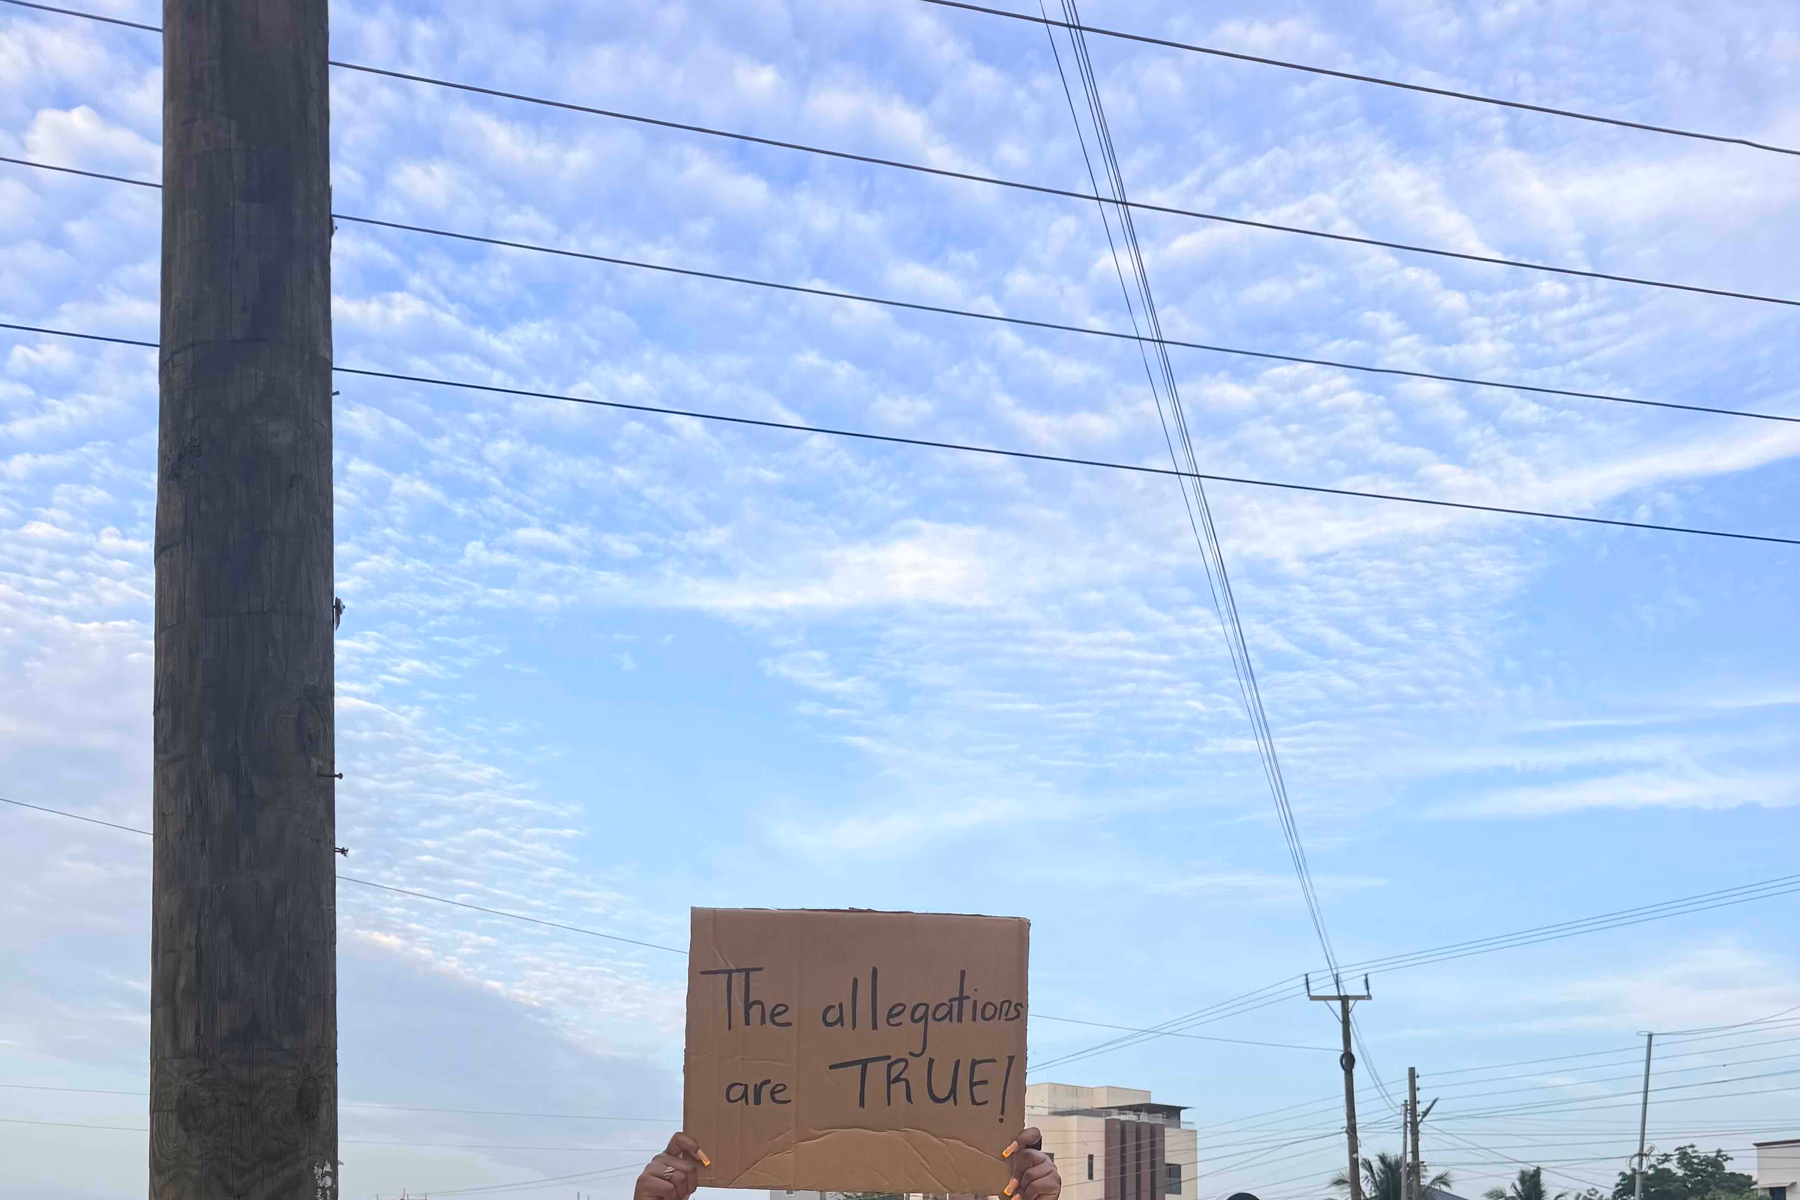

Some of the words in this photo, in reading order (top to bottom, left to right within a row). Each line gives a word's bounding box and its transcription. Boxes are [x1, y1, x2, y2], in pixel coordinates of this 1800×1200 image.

[700, 966, 793, 1031] The
[821, 966, 1024, 1057] allegations
[725, 1078, 792, 1106] are
[828, 1055, 1016, 1124] TRUE!
